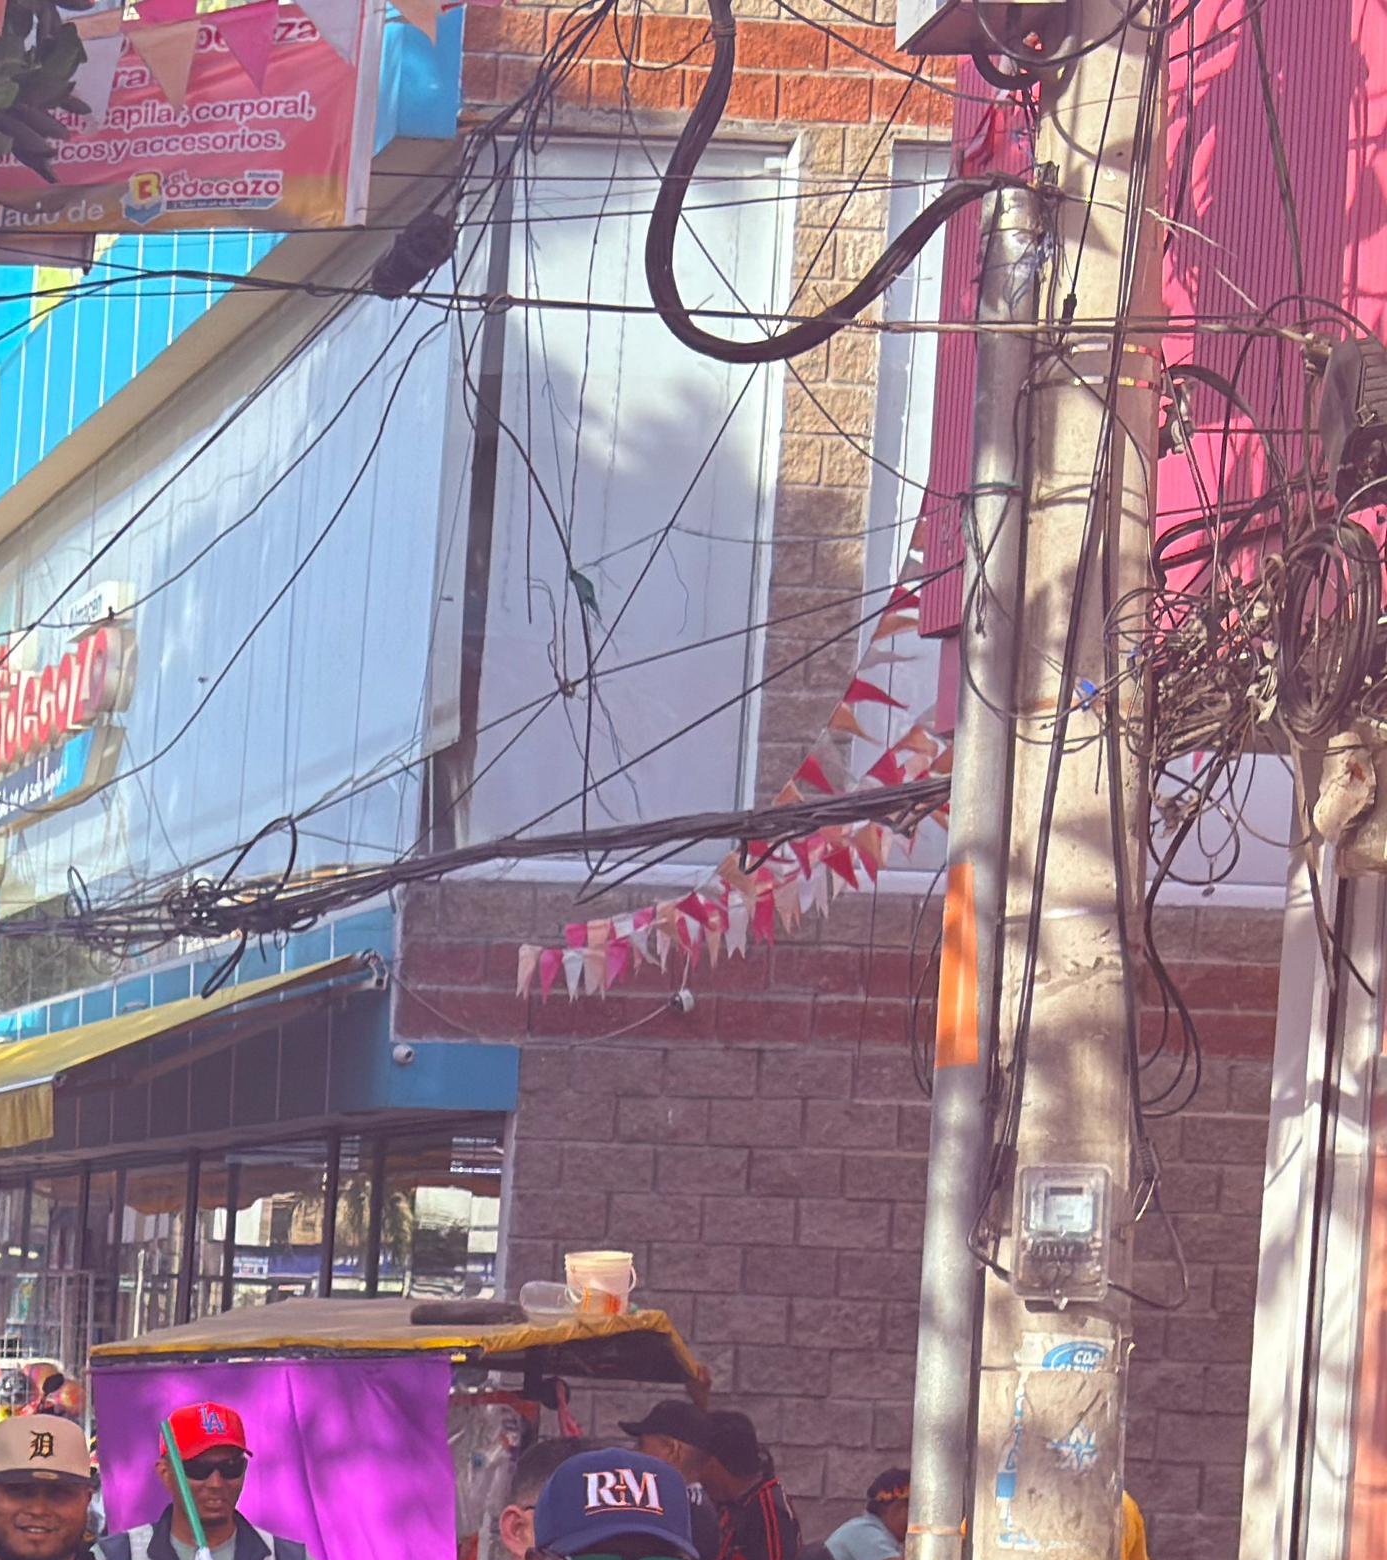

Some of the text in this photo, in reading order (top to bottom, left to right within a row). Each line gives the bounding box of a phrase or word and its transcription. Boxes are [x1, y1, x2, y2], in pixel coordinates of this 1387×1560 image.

[195, 95, 315, 121] corporal,
[112, 141, 128, 165] y
[133, 130, 284, 156] accesorios.
[69, 200, 104, 222] de
[199, 1407, 225, 1434] LA
[30, 1430, 55, 1460] D
